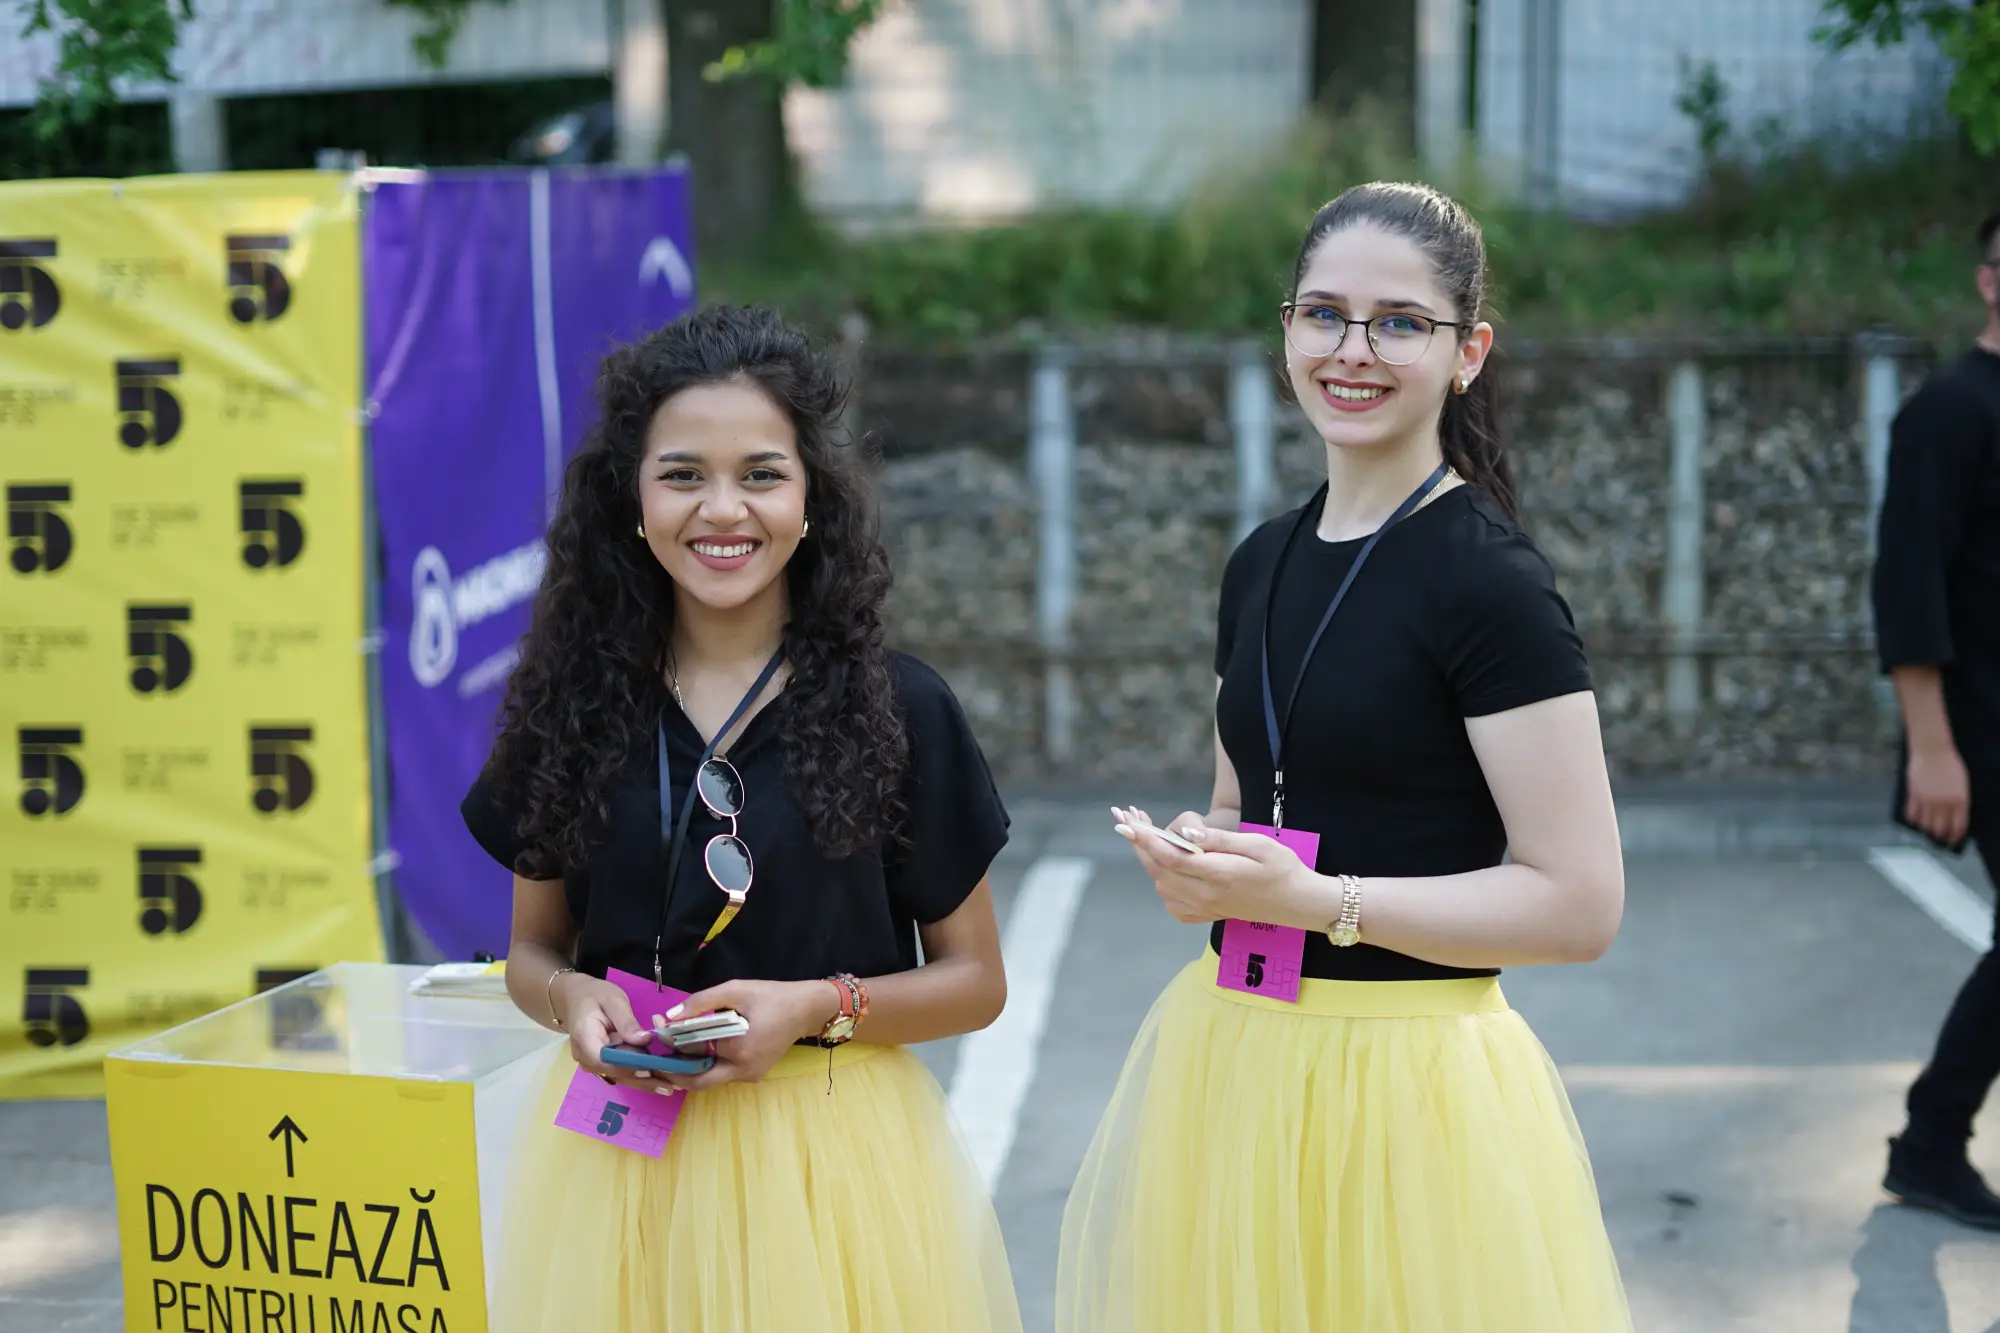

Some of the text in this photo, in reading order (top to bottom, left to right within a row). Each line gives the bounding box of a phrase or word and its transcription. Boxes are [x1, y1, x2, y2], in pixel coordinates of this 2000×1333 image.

[227, 234, 292, 325] 5
[115, 357, 183, 449] 5
[6, 484, 73, 574] 5
[239, 480, 305, 569] 5
[127, 605, 193, 694] 5
[18, 726, 86, 817] 5
[249, 726, 315, 814] 5
[137, 847, 204, 936] 5
[24, 968, 91, 1047] 5
[1245, 952, 1267, 988] 5
[596, 1100, 630, 1137] 5
[145, 1183, 451, 1292] DONEAZĂ
[153, 1278, 315, 1333] PENTRU
